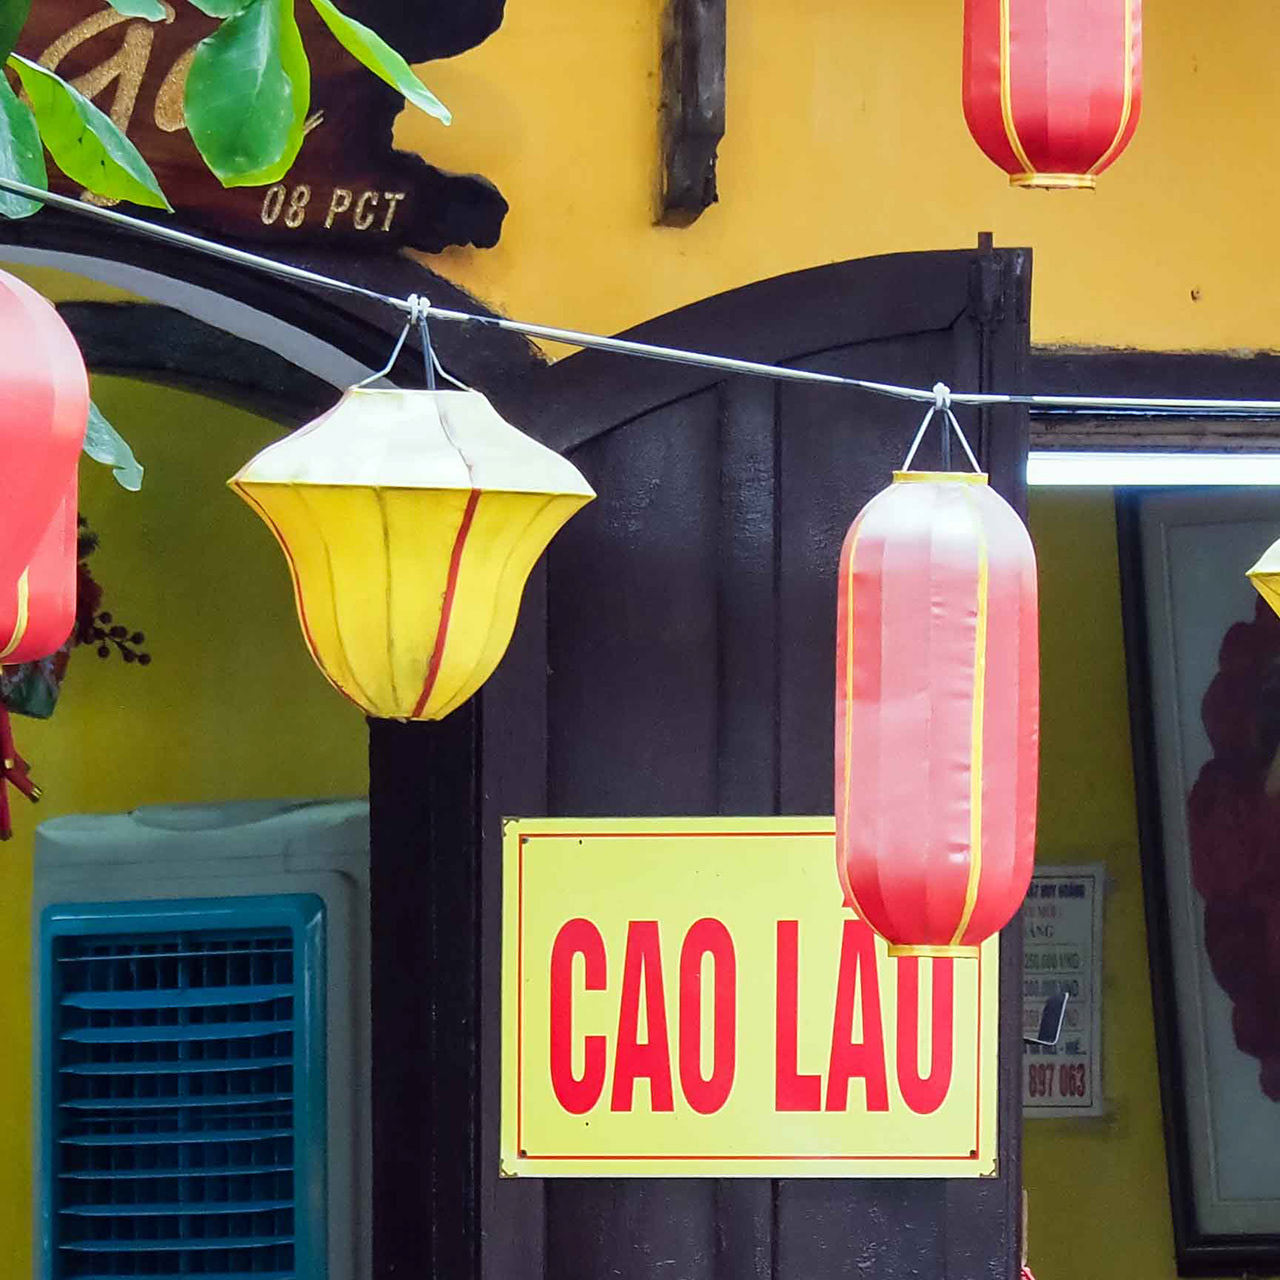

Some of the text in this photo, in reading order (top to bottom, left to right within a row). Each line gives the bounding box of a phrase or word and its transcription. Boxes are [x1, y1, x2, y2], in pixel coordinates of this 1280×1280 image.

[261, 184, 406, 232] 08 PCT
[549, 917, 737, 1116] CAO
